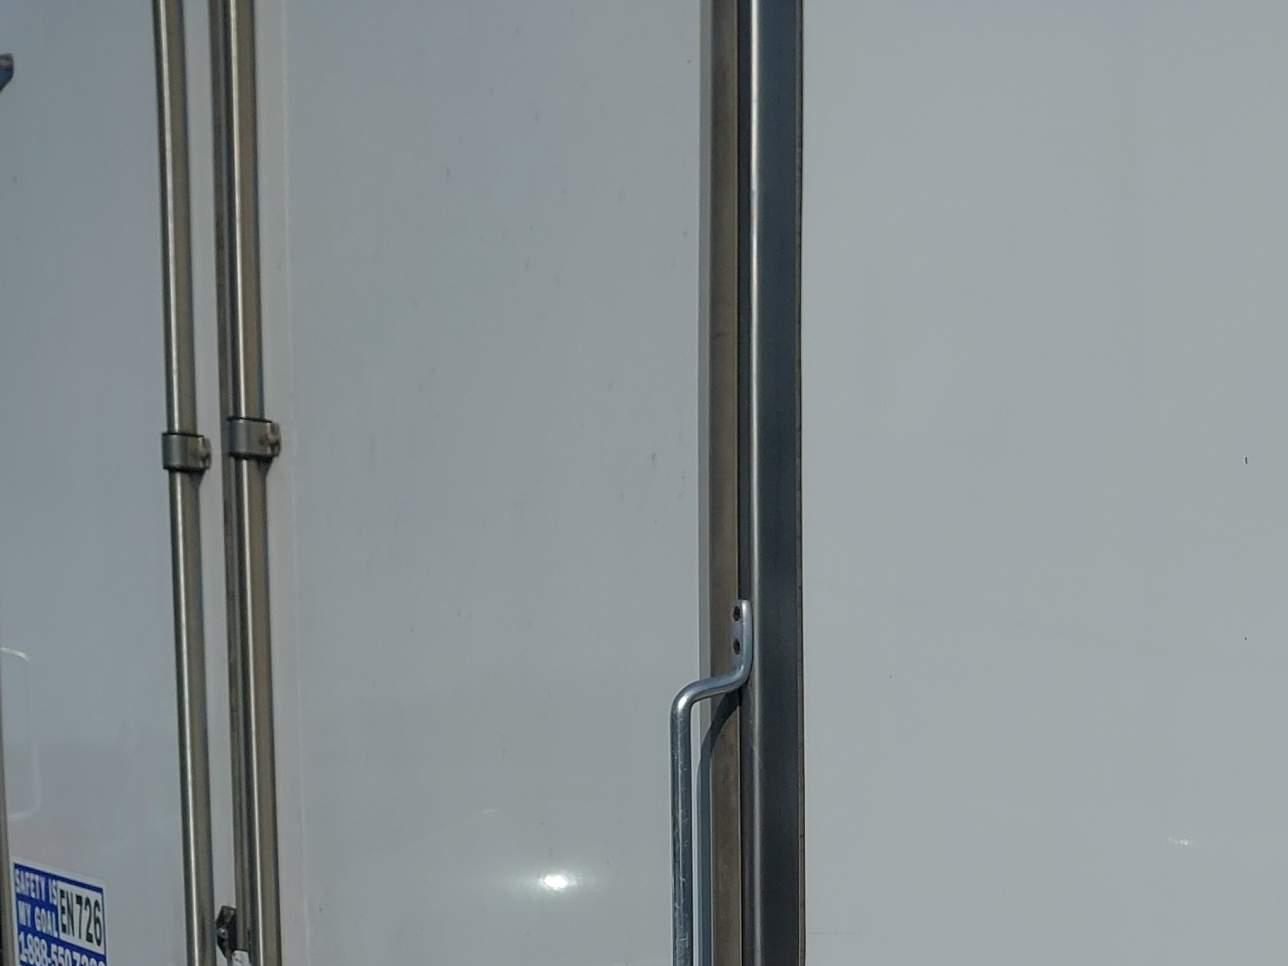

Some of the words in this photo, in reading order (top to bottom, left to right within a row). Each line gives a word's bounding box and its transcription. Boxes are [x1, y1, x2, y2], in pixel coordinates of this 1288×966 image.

[15, 869, 46, 901] SAFETY
[48, 879, 58, 906] IS
[18, 900, 32, 927] MY
[34, 906, 59, 938] GOAL
